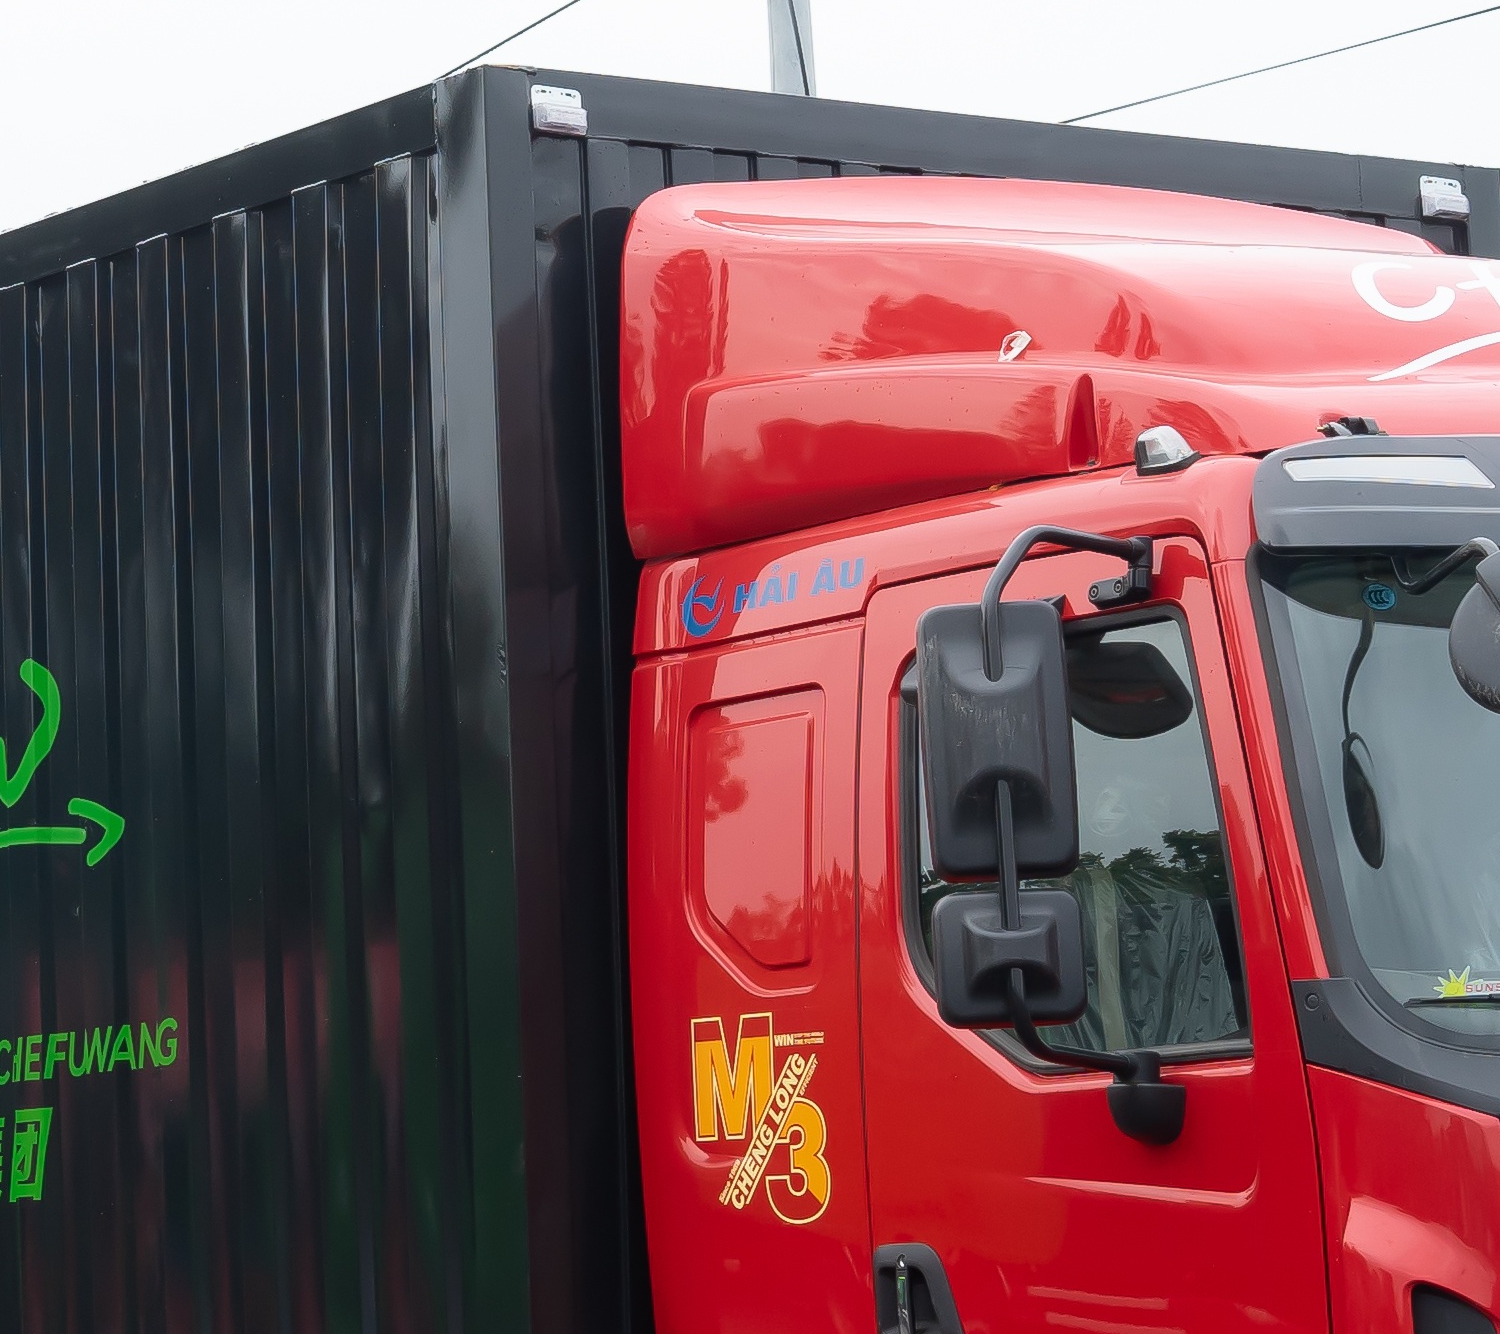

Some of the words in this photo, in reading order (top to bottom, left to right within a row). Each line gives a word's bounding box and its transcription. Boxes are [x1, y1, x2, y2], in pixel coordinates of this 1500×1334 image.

[732, 563, 798, 613] HẢI
[810, 556, 865, 597] ÂU
[731, 1122, 774, 1210] CHENG
[767, 1052, 806, 1124] LONG
